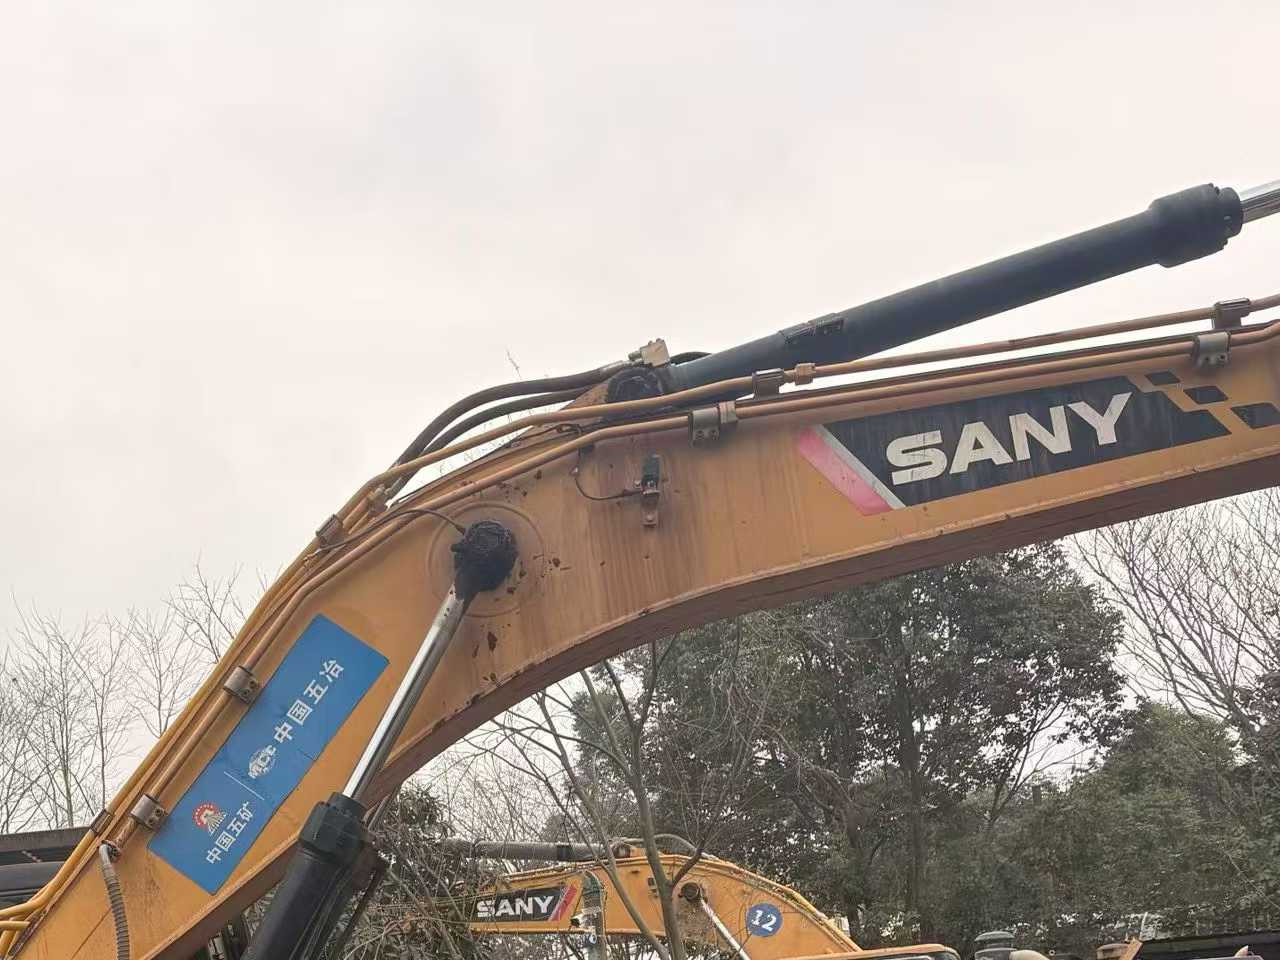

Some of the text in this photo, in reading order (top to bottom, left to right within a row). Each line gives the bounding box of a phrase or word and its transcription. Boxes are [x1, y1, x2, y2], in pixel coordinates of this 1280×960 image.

[886, 392, 1133, 486] SANY
[274, 660, 344, 743] 中国五冶
[206, 801, 253, 864] 中国五矿
[477, 896, 554, 917] SANY
[751, 909, 777, 931] 12
